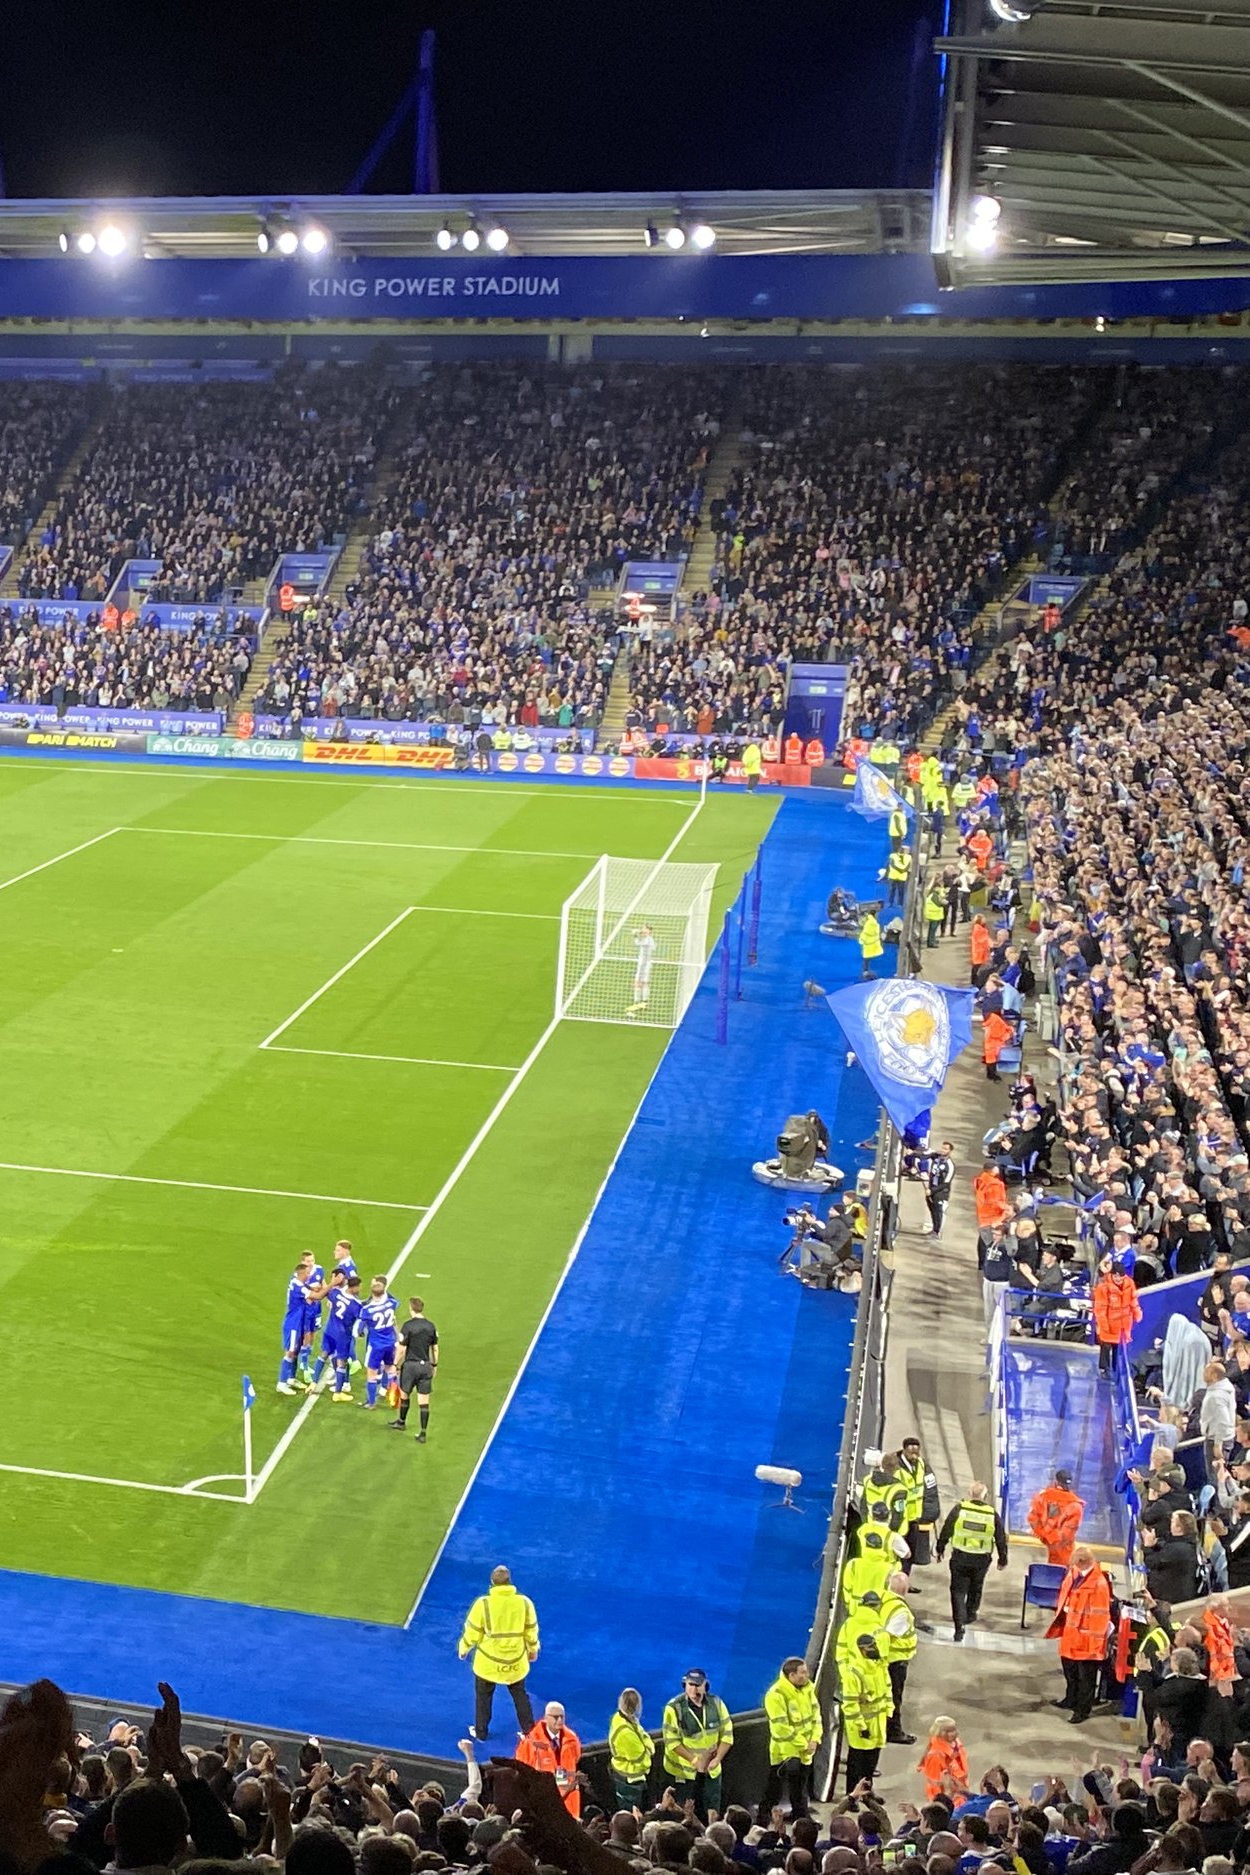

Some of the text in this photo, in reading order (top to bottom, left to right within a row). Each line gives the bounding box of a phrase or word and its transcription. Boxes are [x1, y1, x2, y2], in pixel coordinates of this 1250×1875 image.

[308, 276, 560, 297] KING POWER STADIUM
[34, 713, 58, 723] KING
[121, 717, 154, 728] POWER
[185, 719, 218, 731] POWER
[391, 729, 417, 741] KING
[173, 737, 219, 757] Chang
[251, 740, 300, 761] Chang
[314, 745, 373, 761] DHL
[336, 1300, 347, 1321] 2
[372, 1308, 395, 1330] 22
